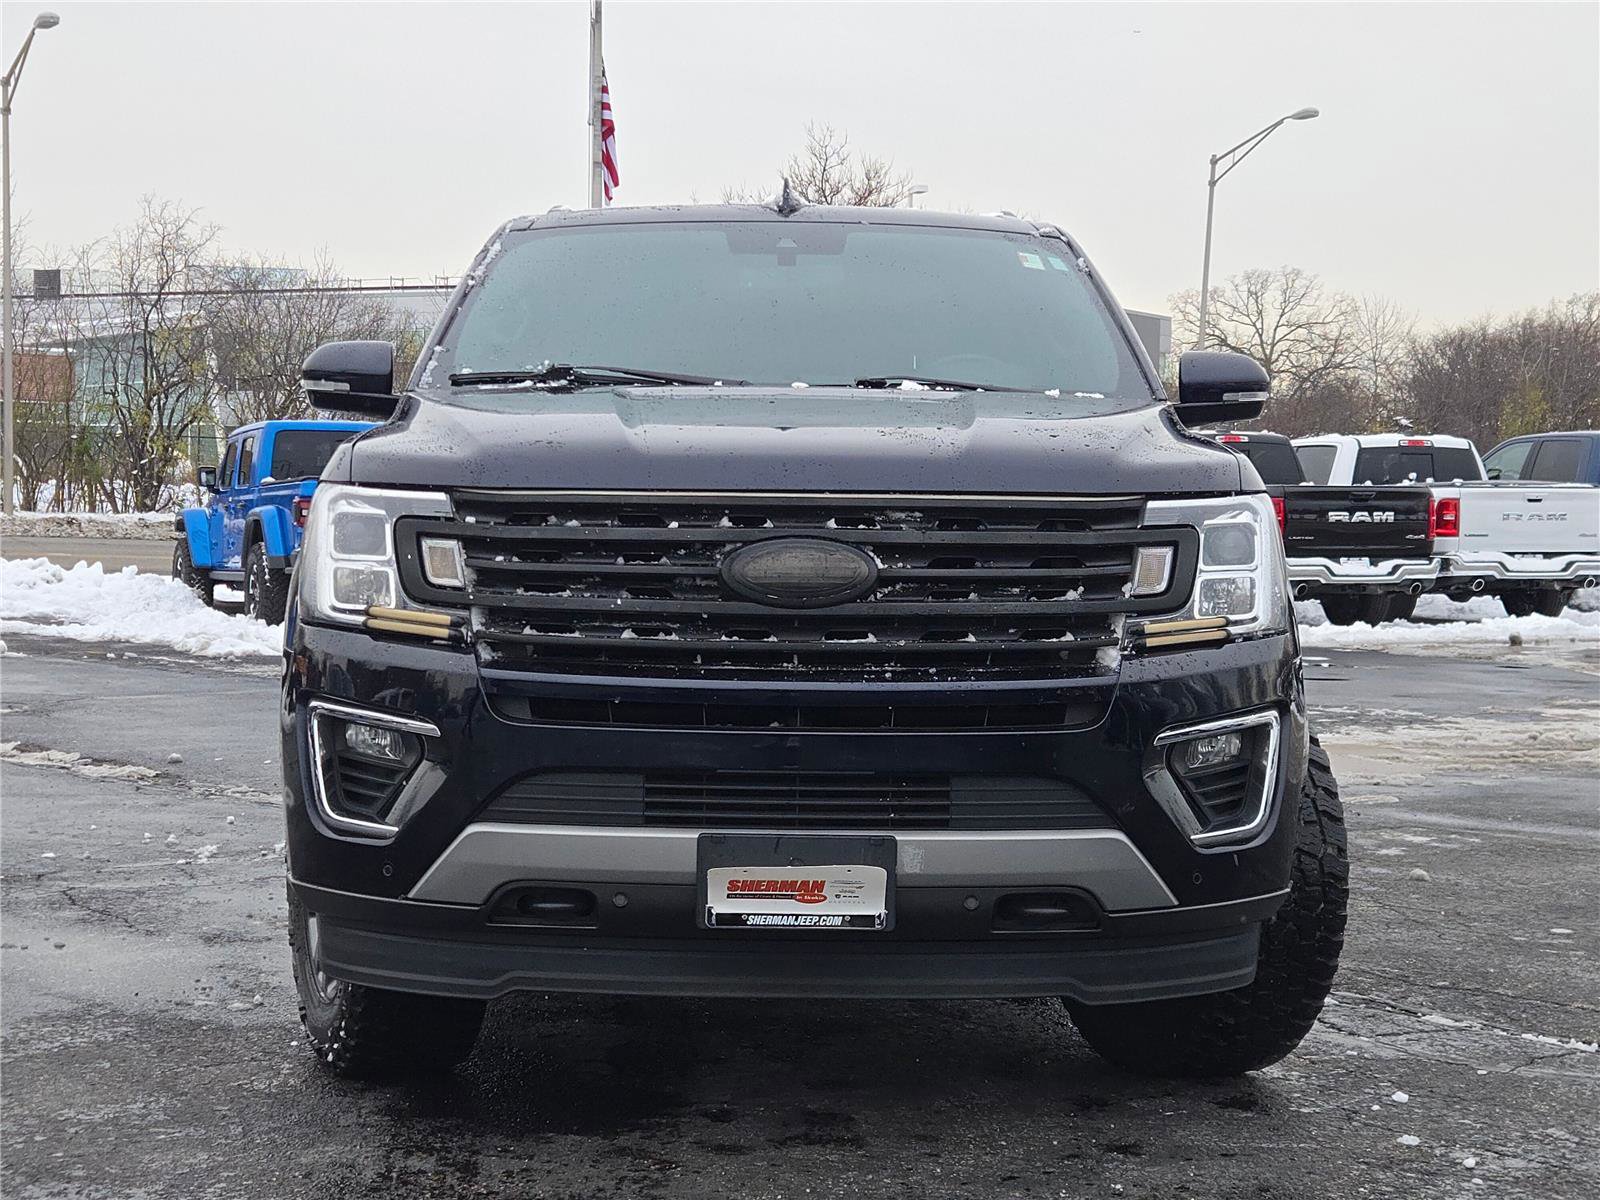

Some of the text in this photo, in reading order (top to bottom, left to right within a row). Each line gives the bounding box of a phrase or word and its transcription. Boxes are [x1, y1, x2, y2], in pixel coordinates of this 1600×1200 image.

[1328, 511, 1395, 523] RAM
[1502, 512, 1568, 522] RAM
[727, 879, 826, 893] SHERMAN
[746, 915, 843, 926] SHERMANJEEP.COM
